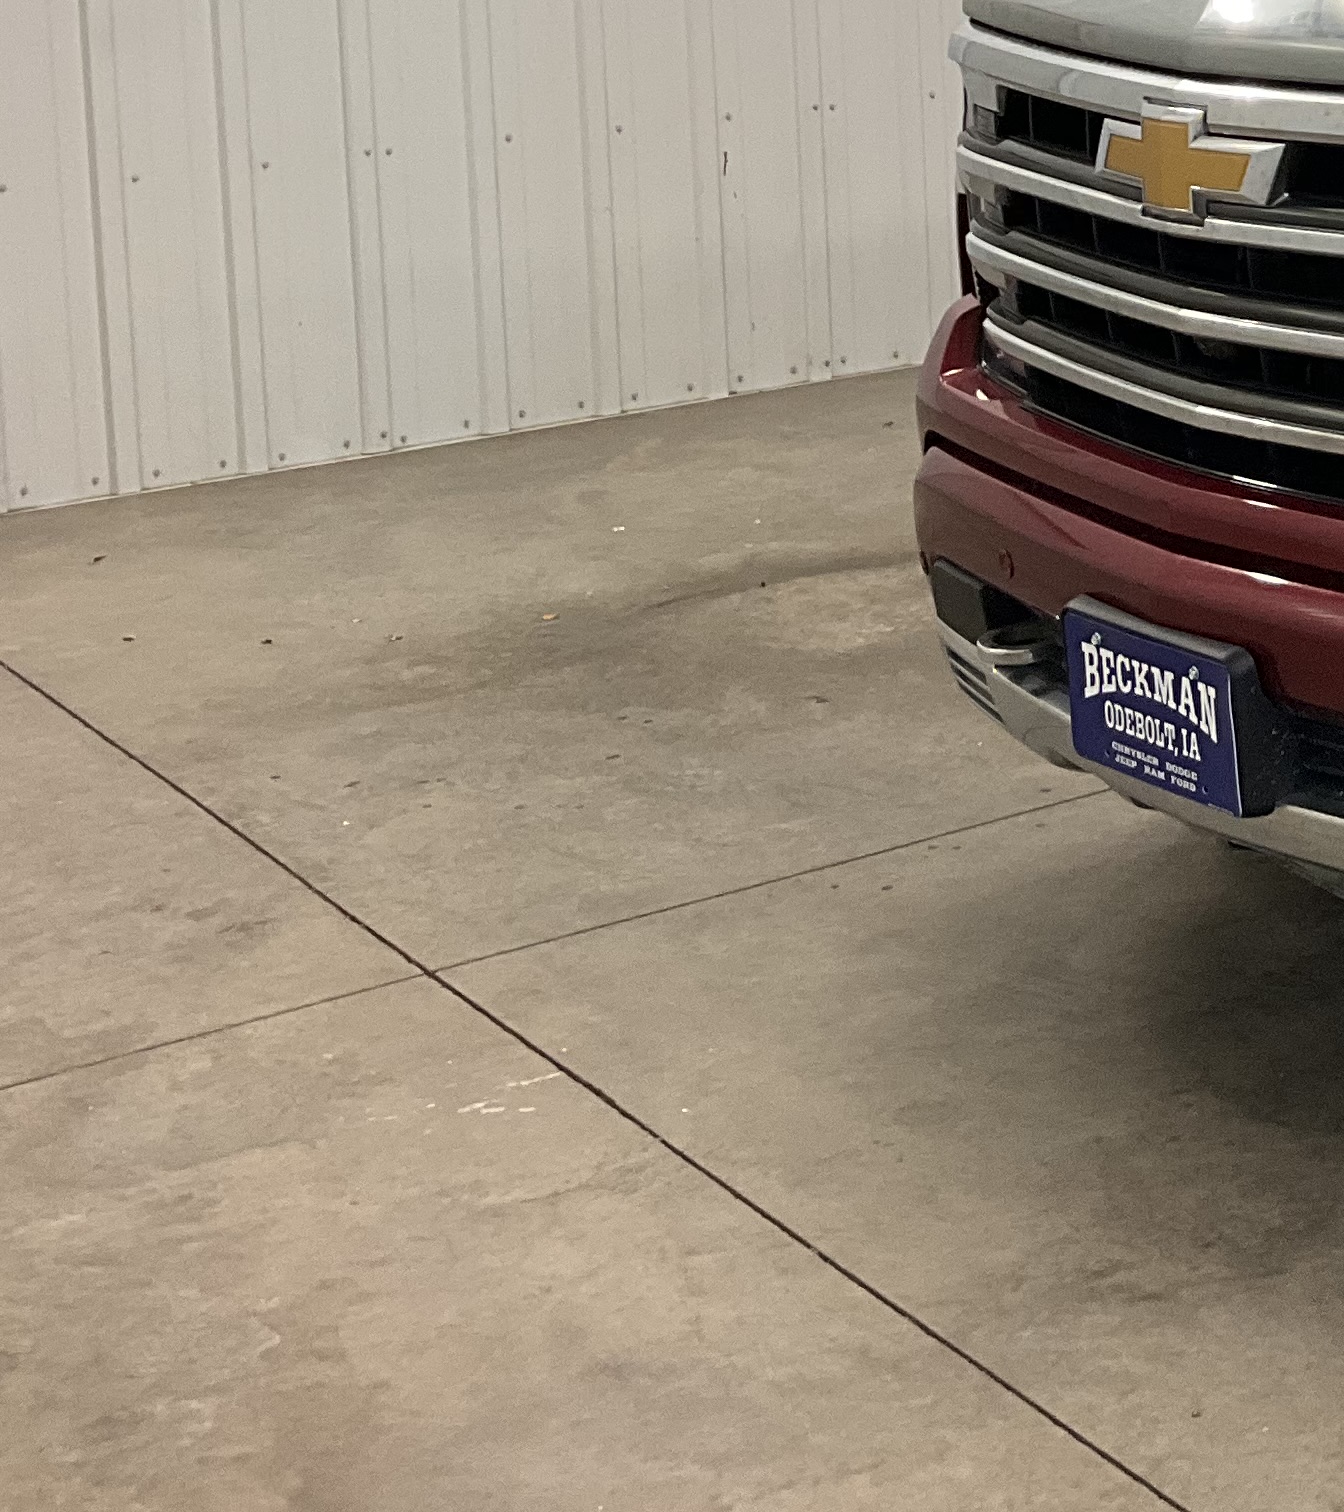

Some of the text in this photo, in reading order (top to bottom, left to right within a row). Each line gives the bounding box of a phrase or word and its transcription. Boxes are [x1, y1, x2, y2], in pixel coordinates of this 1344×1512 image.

[1081, 641, 1218, 744] BECKMAN
[1104, 700, 1202, 762] ODEBOLT, IA
[1143, 764, 1166, 781] RAM
[1170, 775, 1197, 792] FORD
[1165, 761, 1198, 781] DODGE
